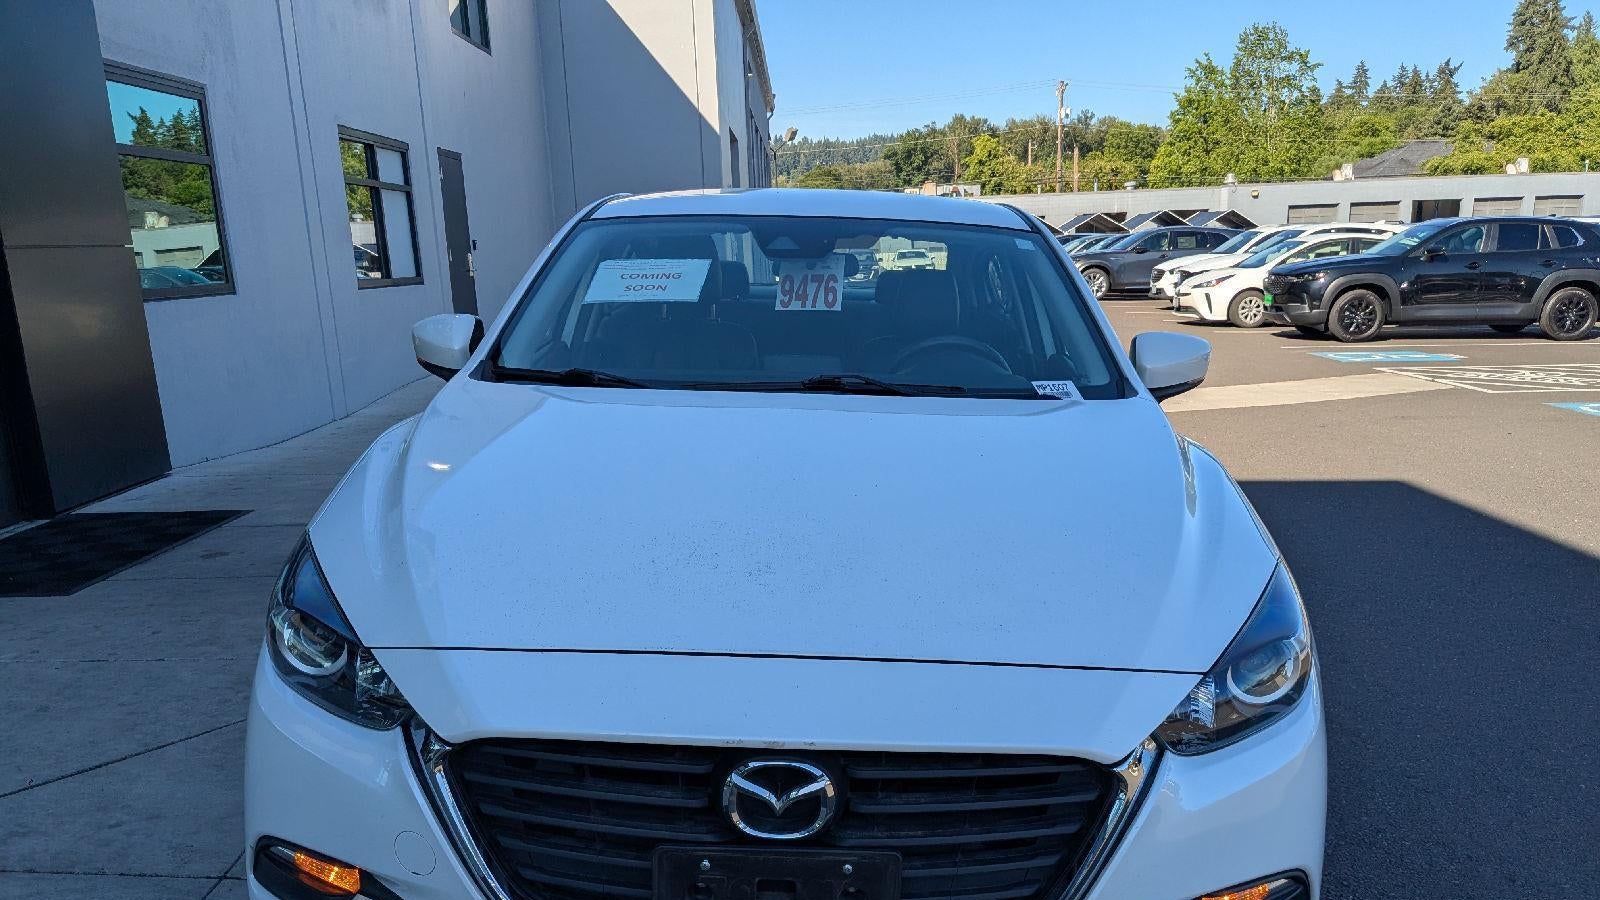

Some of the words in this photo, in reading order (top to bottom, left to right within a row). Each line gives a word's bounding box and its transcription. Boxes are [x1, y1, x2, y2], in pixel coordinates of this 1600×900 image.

[620, 272, 682, 280] COMING
[623, 284, 668, 292] SOON
[779, 274, 839, 309] 9476
